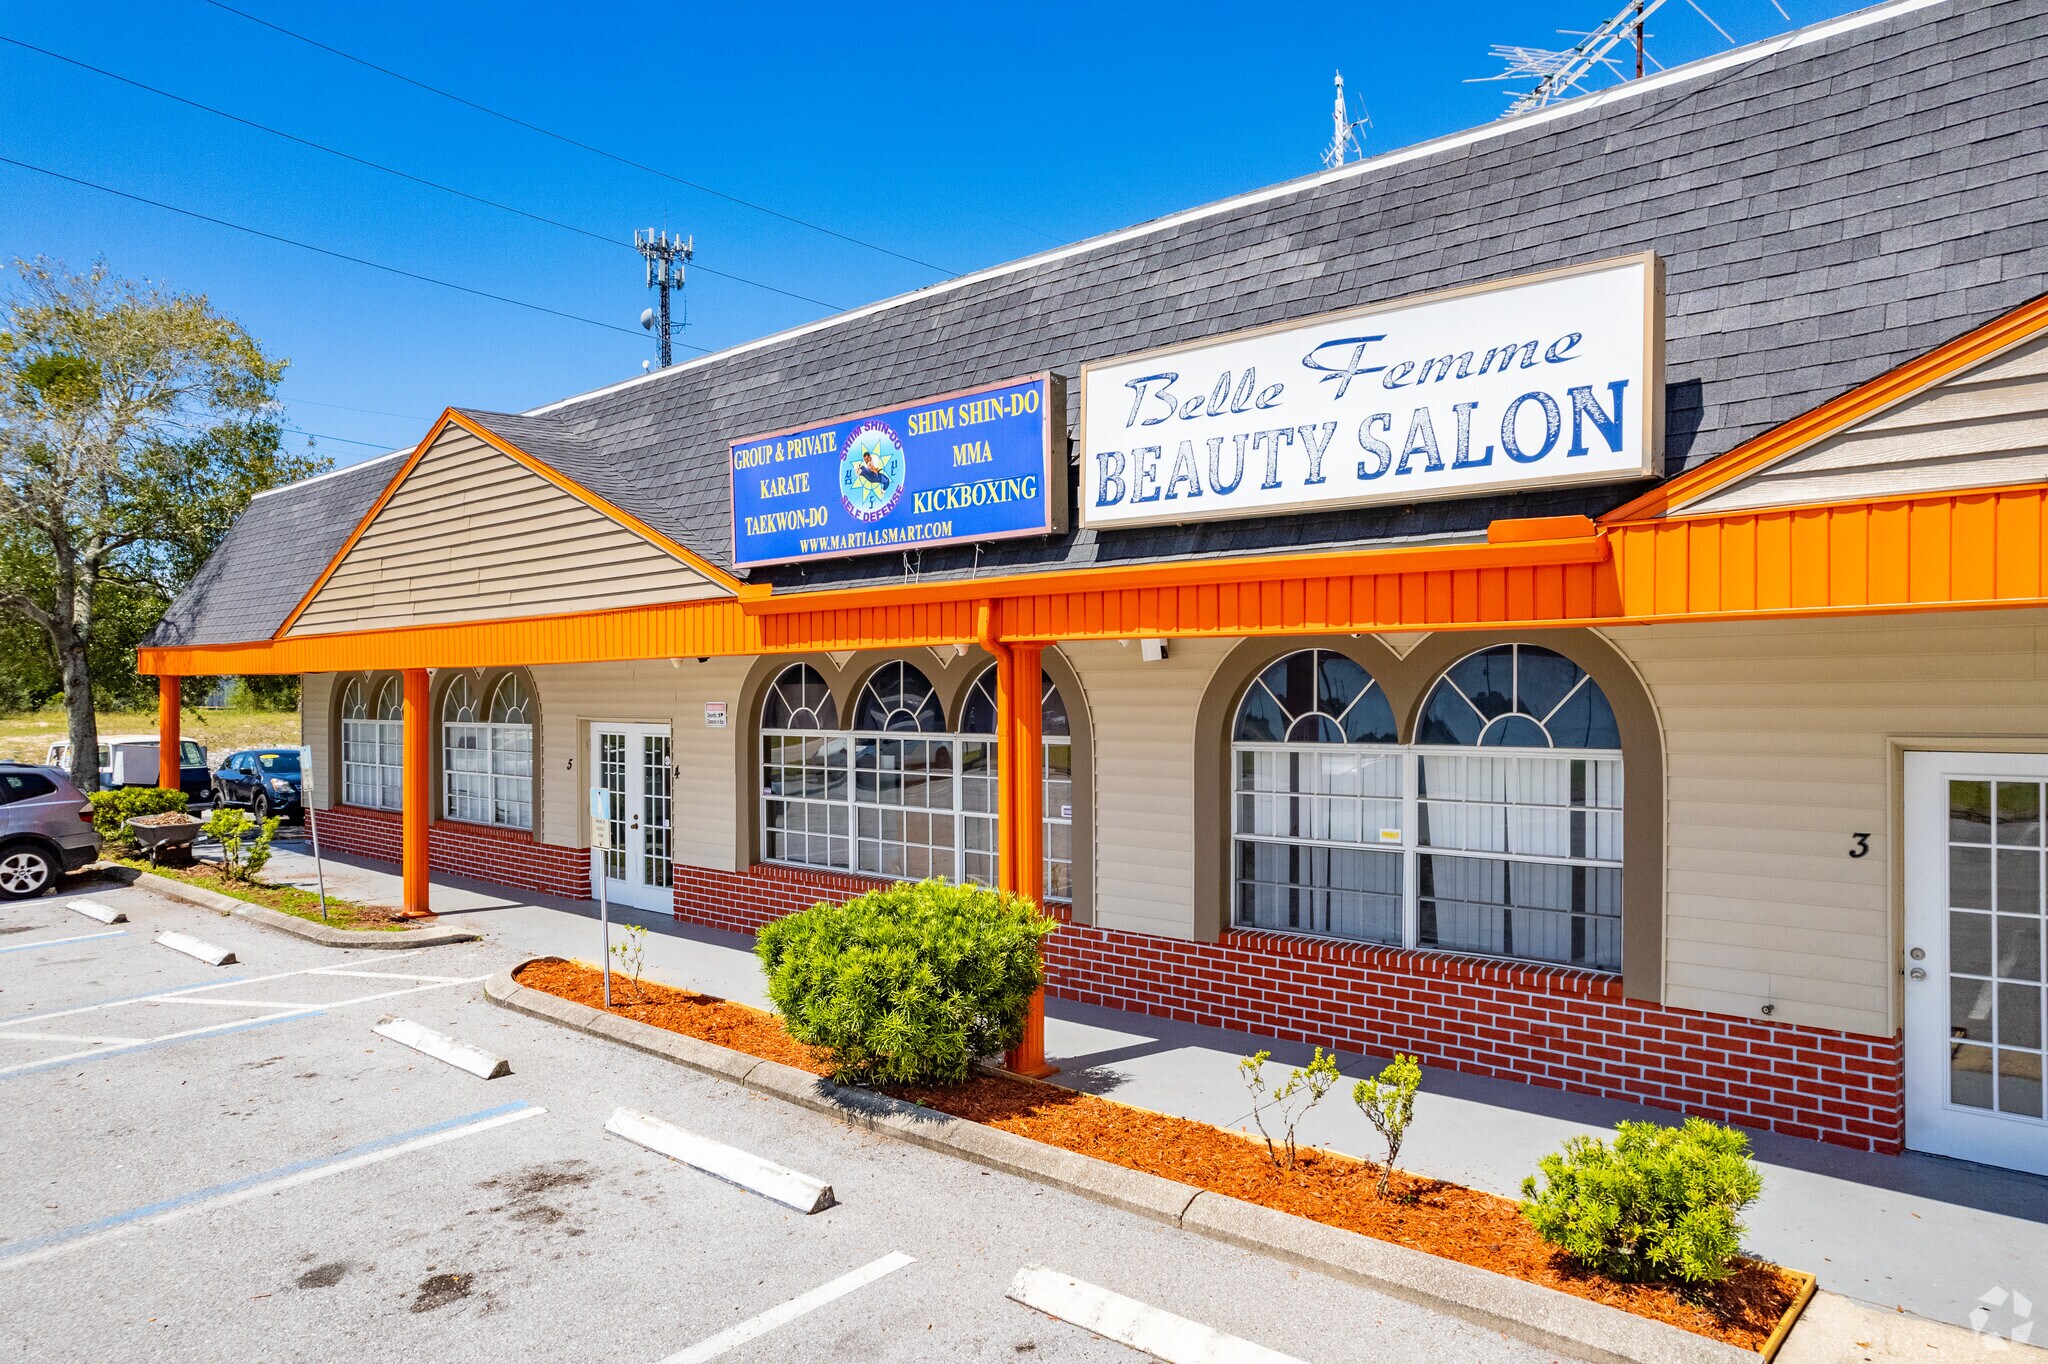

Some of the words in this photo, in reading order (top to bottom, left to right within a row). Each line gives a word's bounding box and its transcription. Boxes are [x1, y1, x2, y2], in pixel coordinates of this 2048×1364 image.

[1125, 366, 1284, 428] Belle
[1302, 332, 1583, 400] Femme
[908, 407, 955, 436] SHIM
[958, 389, 1039, 427] SHIN-DO
[864, 419, 903, 450] SHIN-DO
[1095, 421, 1338, 508] BEAUTY
[1357, 379, 1630, 482] SALON
[734, 445, 773, 470] GROUP
[775, 442, 785, 462] &
[787, 431, 837, 460] PRIVATE
[953, 440, 993, 467] MMA
[760, 472, 810, 499] KARATE
[913, 476, 1037, 514] KICKBOXING
[841, 494, 862, 519] SELF
[863, 484, 905, 522] DEFENSE
[745, 506, 828, 536] TAEKWON-DO
[800, 521, 952, 553] WWW.MARTIALSMART.COM
[566, 758, 574, 770] 5
[674, 764, 680, 779] 4
[1849, 832, 1871, 858] 3
